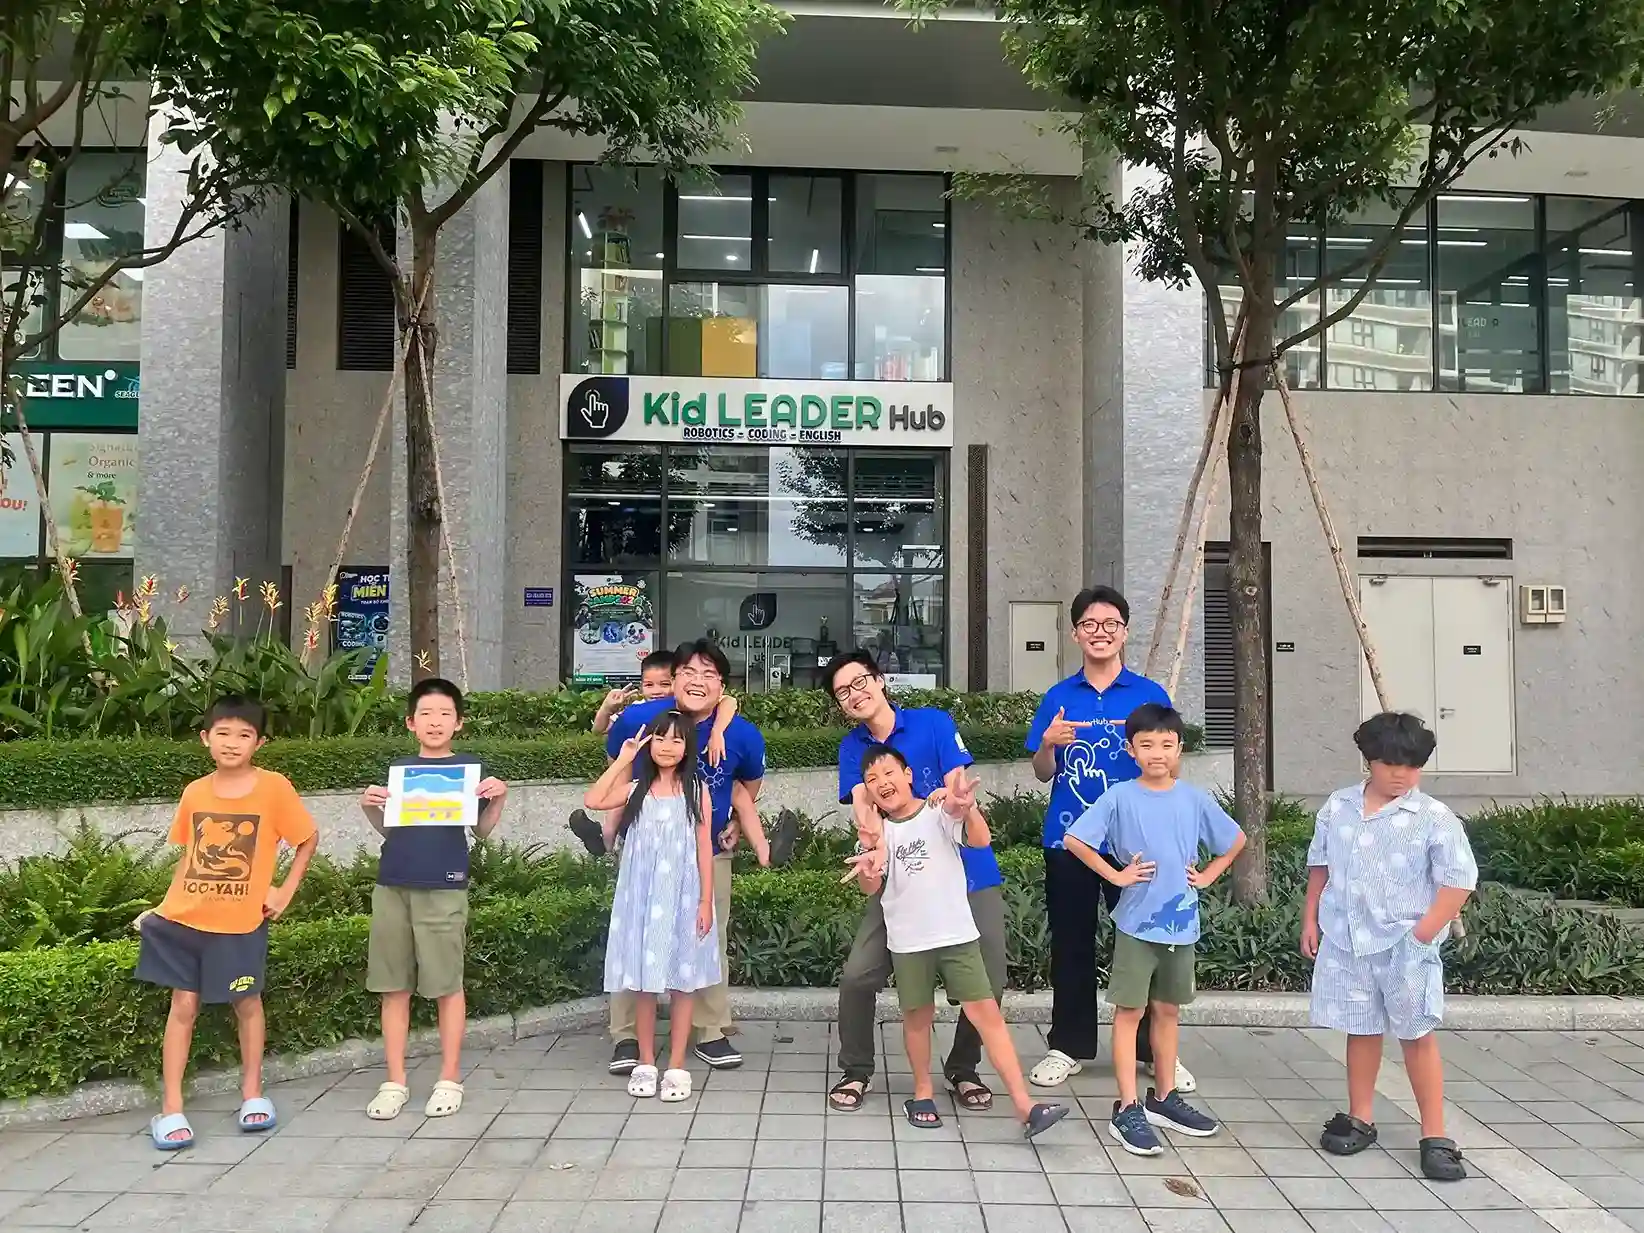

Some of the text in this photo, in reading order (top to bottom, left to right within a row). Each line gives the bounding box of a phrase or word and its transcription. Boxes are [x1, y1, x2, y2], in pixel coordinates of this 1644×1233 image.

[643, 390, 946, 431] Kid LEADER Hub
[683, 427, 735, 439] ROBOTICS
[748, 429, 787, 440] CODING
[799, 429, 842, 441] ENGLISH
[88, 455, 135, 469] Organic
[0, 498, 28, 511] OU!
[589, 586, 638, 597] SUMMER
[744, 636, 792, 648] LEADE
